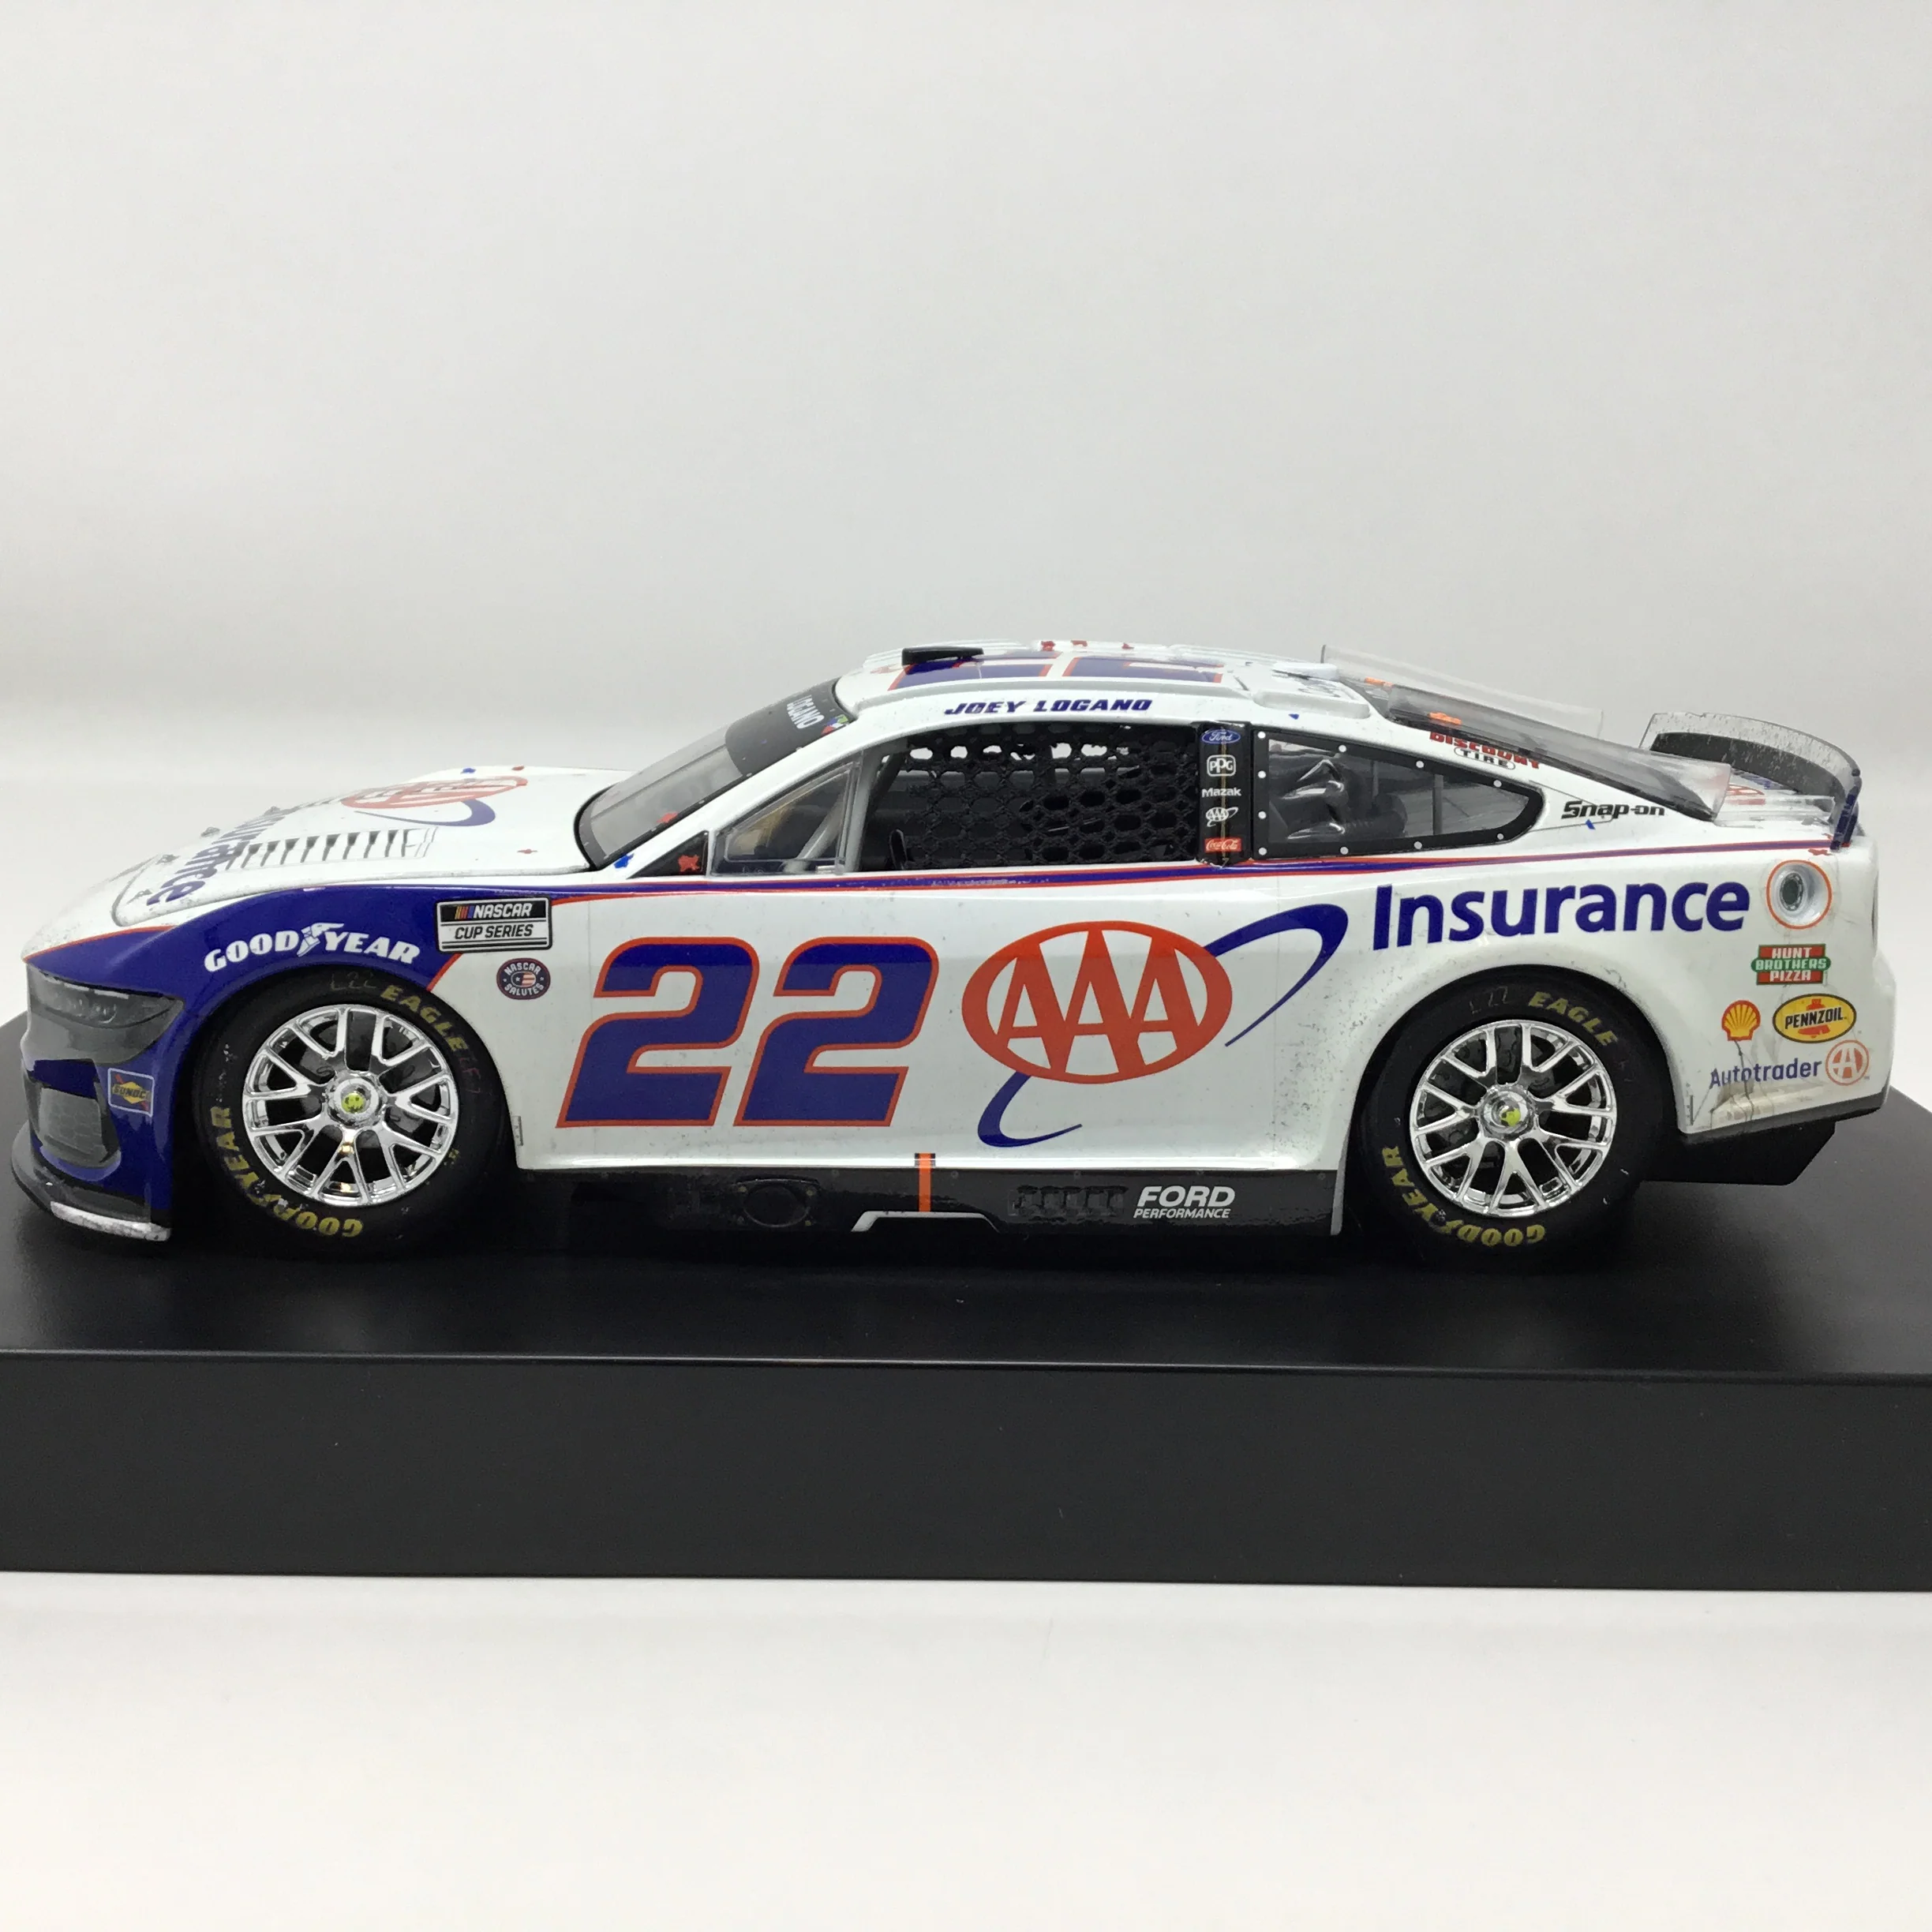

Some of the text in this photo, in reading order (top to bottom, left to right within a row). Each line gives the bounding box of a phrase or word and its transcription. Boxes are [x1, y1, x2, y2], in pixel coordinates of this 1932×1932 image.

[944, 698, 1153, 715] JOEY LOGANO
[1207, 730, 1235, 743] Ford
[1428, 731, 1540, 769] DISCOUNT
[1209, 757, 1234, 773] PPG
[1461, 750, 1510, 768] TIRE
[1201, 787, 1242, 798] Mazak
[1205, 807, 1230, 822] AAA
[1560, 799, 1665, 819] Snap-on
[473, 903, 533, 919] NASCAR
[1372, 880, 1751, 951] Insurance
[455, 923, 534, 939] CUP SERIES
[1771, 947, 1813, 959] HUNT
[504, 962, 541, 975] NASCAR
[1755, 958, 1827, 971] BROTHERS
[1769, 970, 1812, 983] PIZZA
[504, 983, 545, 996] SALUTES
[985, 924, 1209, 1082] AAA
[380, 983, 469, 1053] EAGLE
[1528, 990, 1618, 1047] EAGLE
[1784, 1006, 1844, 1030] PENNZOIL
[555, 936, 940, 1129] 22
[1709, 1058, 1822, 1090] Autotrader
[112, 1084, 153, 1103] SUNOC
[1137, 1185, 1236, 1208] FORD
[1133, 1208, 1231, 1219] PERFORMANCE
